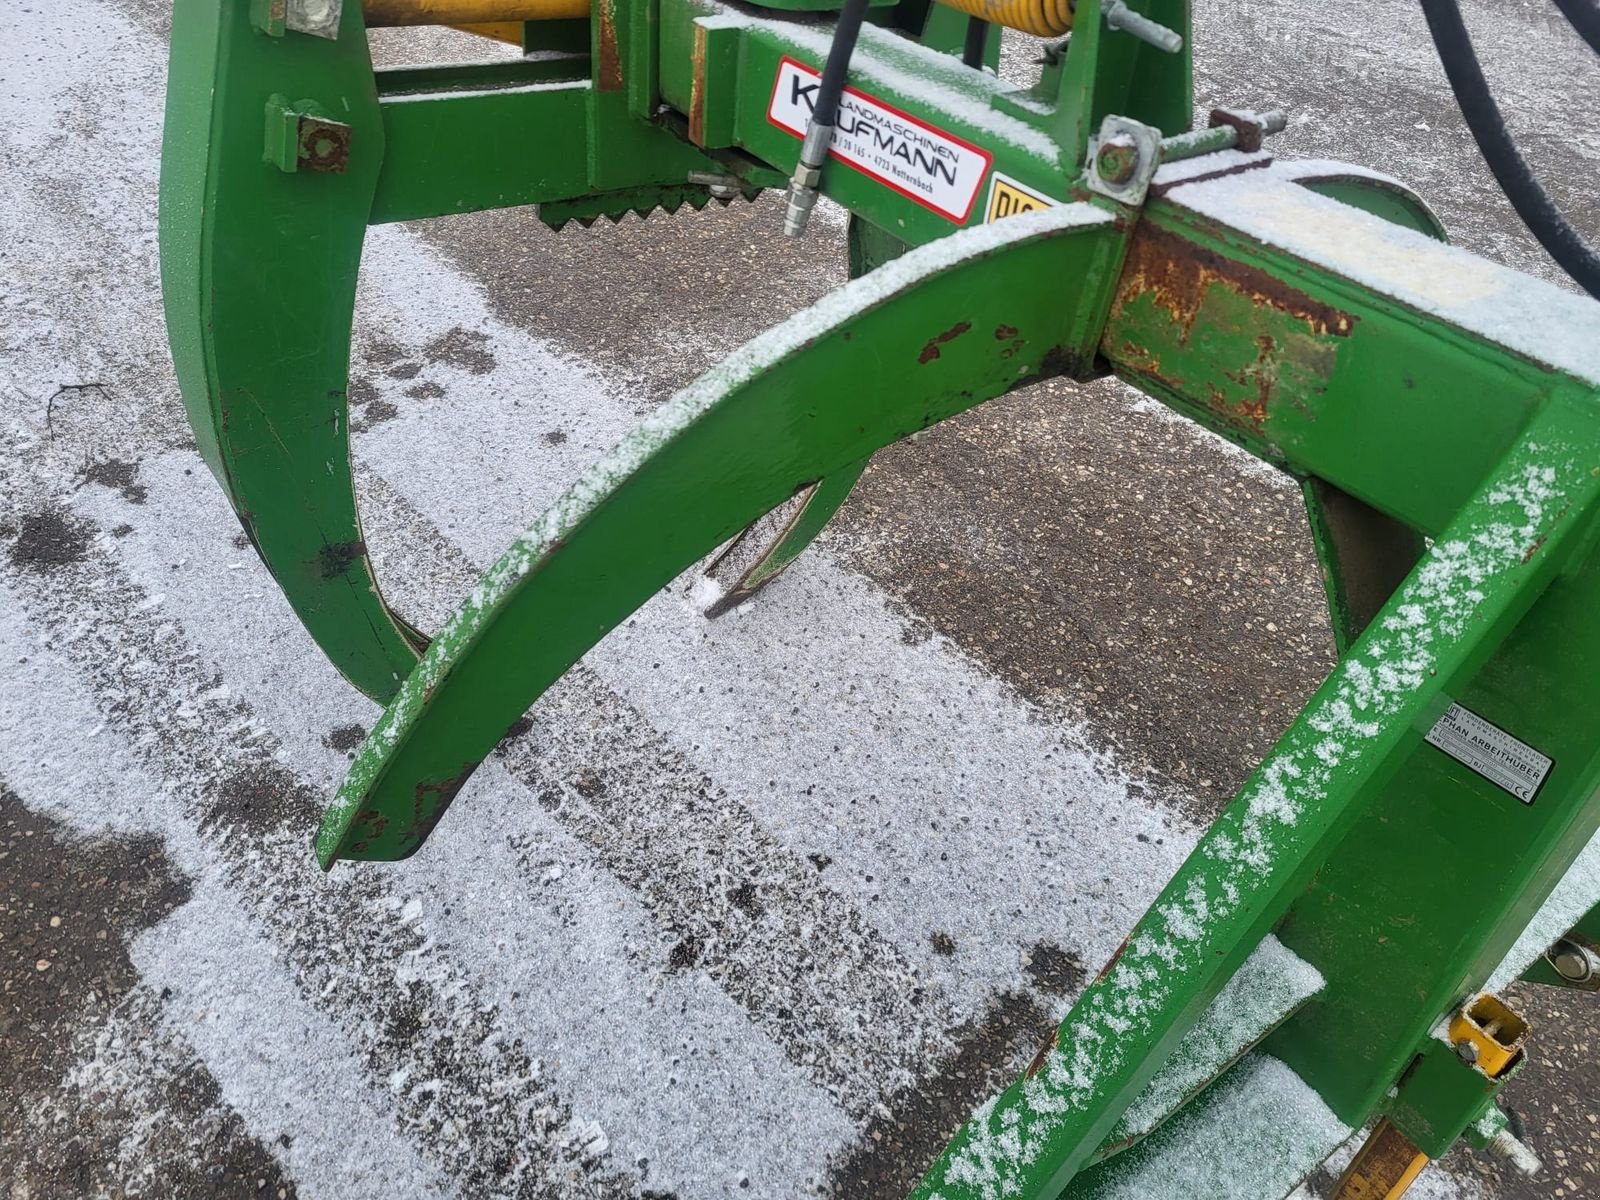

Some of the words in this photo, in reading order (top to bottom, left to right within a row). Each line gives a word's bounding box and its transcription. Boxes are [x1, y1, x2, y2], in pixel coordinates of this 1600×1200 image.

[791, 74, 957, 187] KUFMANN
[840, 99, 960, 163] LANDMASCHINEN
[1471, 735, 1541, 780] ARBEITHUBER
